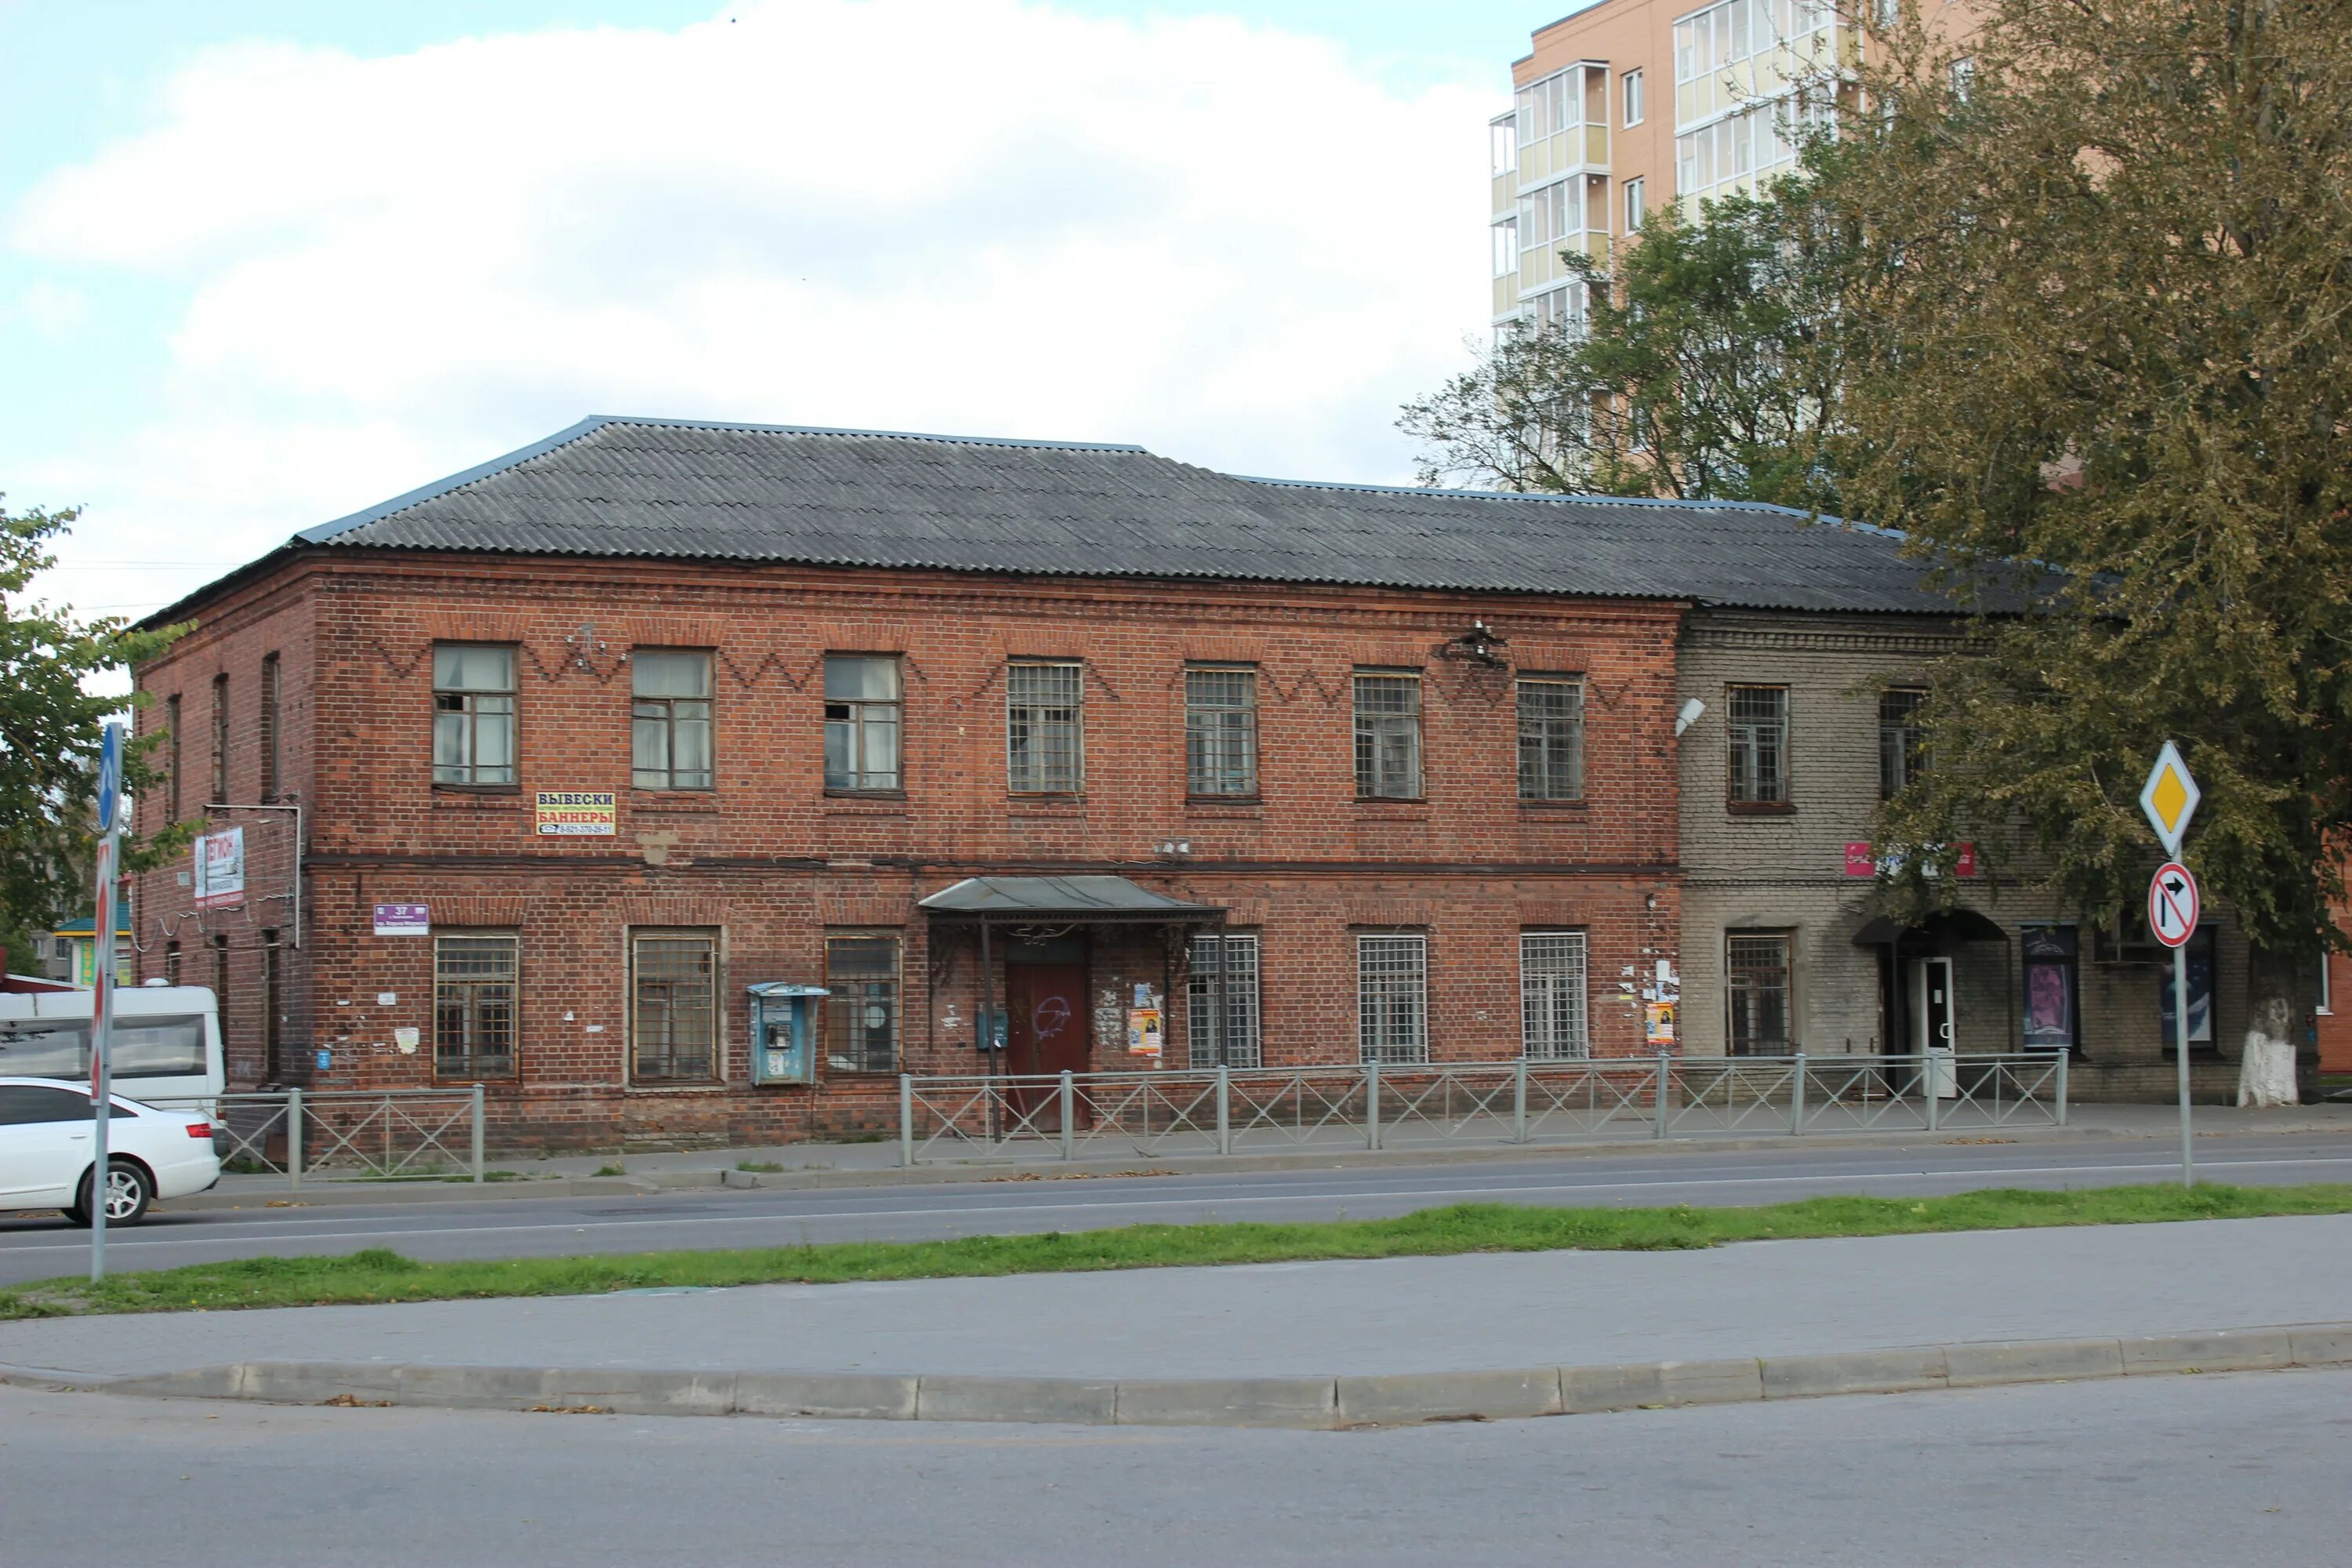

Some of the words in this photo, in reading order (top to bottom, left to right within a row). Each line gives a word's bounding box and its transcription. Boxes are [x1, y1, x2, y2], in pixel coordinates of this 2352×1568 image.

[539, 793, 613, 804] ВЫВЕСКИ
[539, 811, 614, 822] БАННЕРЫ
[395, 906, 408, 916] 37
